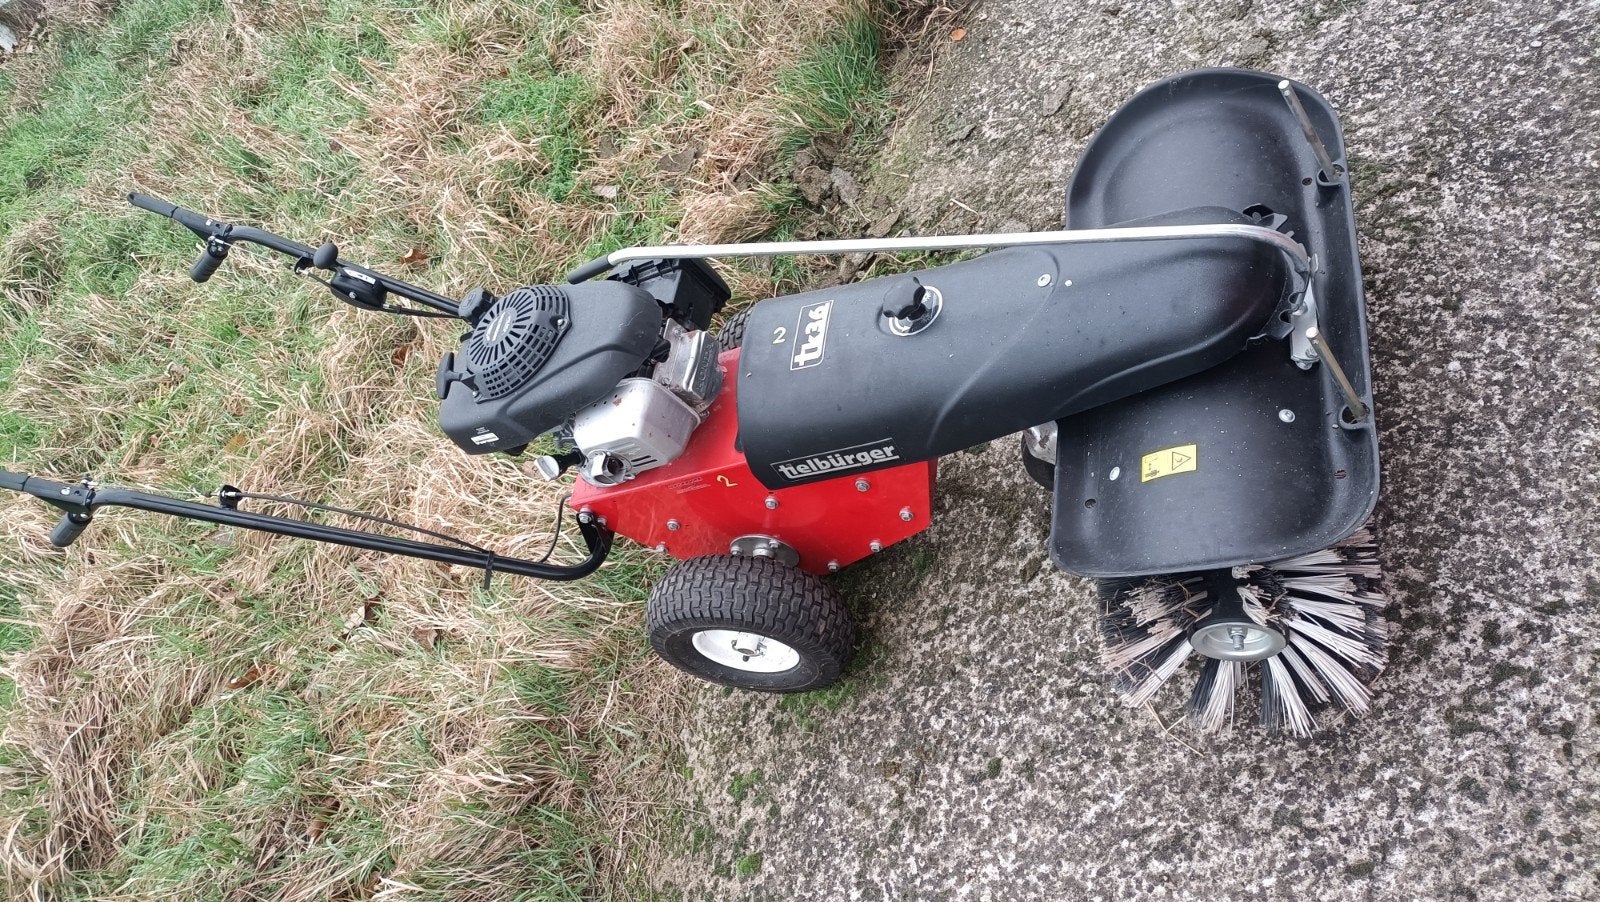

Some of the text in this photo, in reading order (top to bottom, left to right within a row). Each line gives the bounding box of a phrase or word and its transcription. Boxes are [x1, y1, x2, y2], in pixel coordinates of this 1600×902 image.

[772, 326, 787, 344] 2
[778, 445, 900, 479] tielbürger
[716, 474, 738, 487] 2
